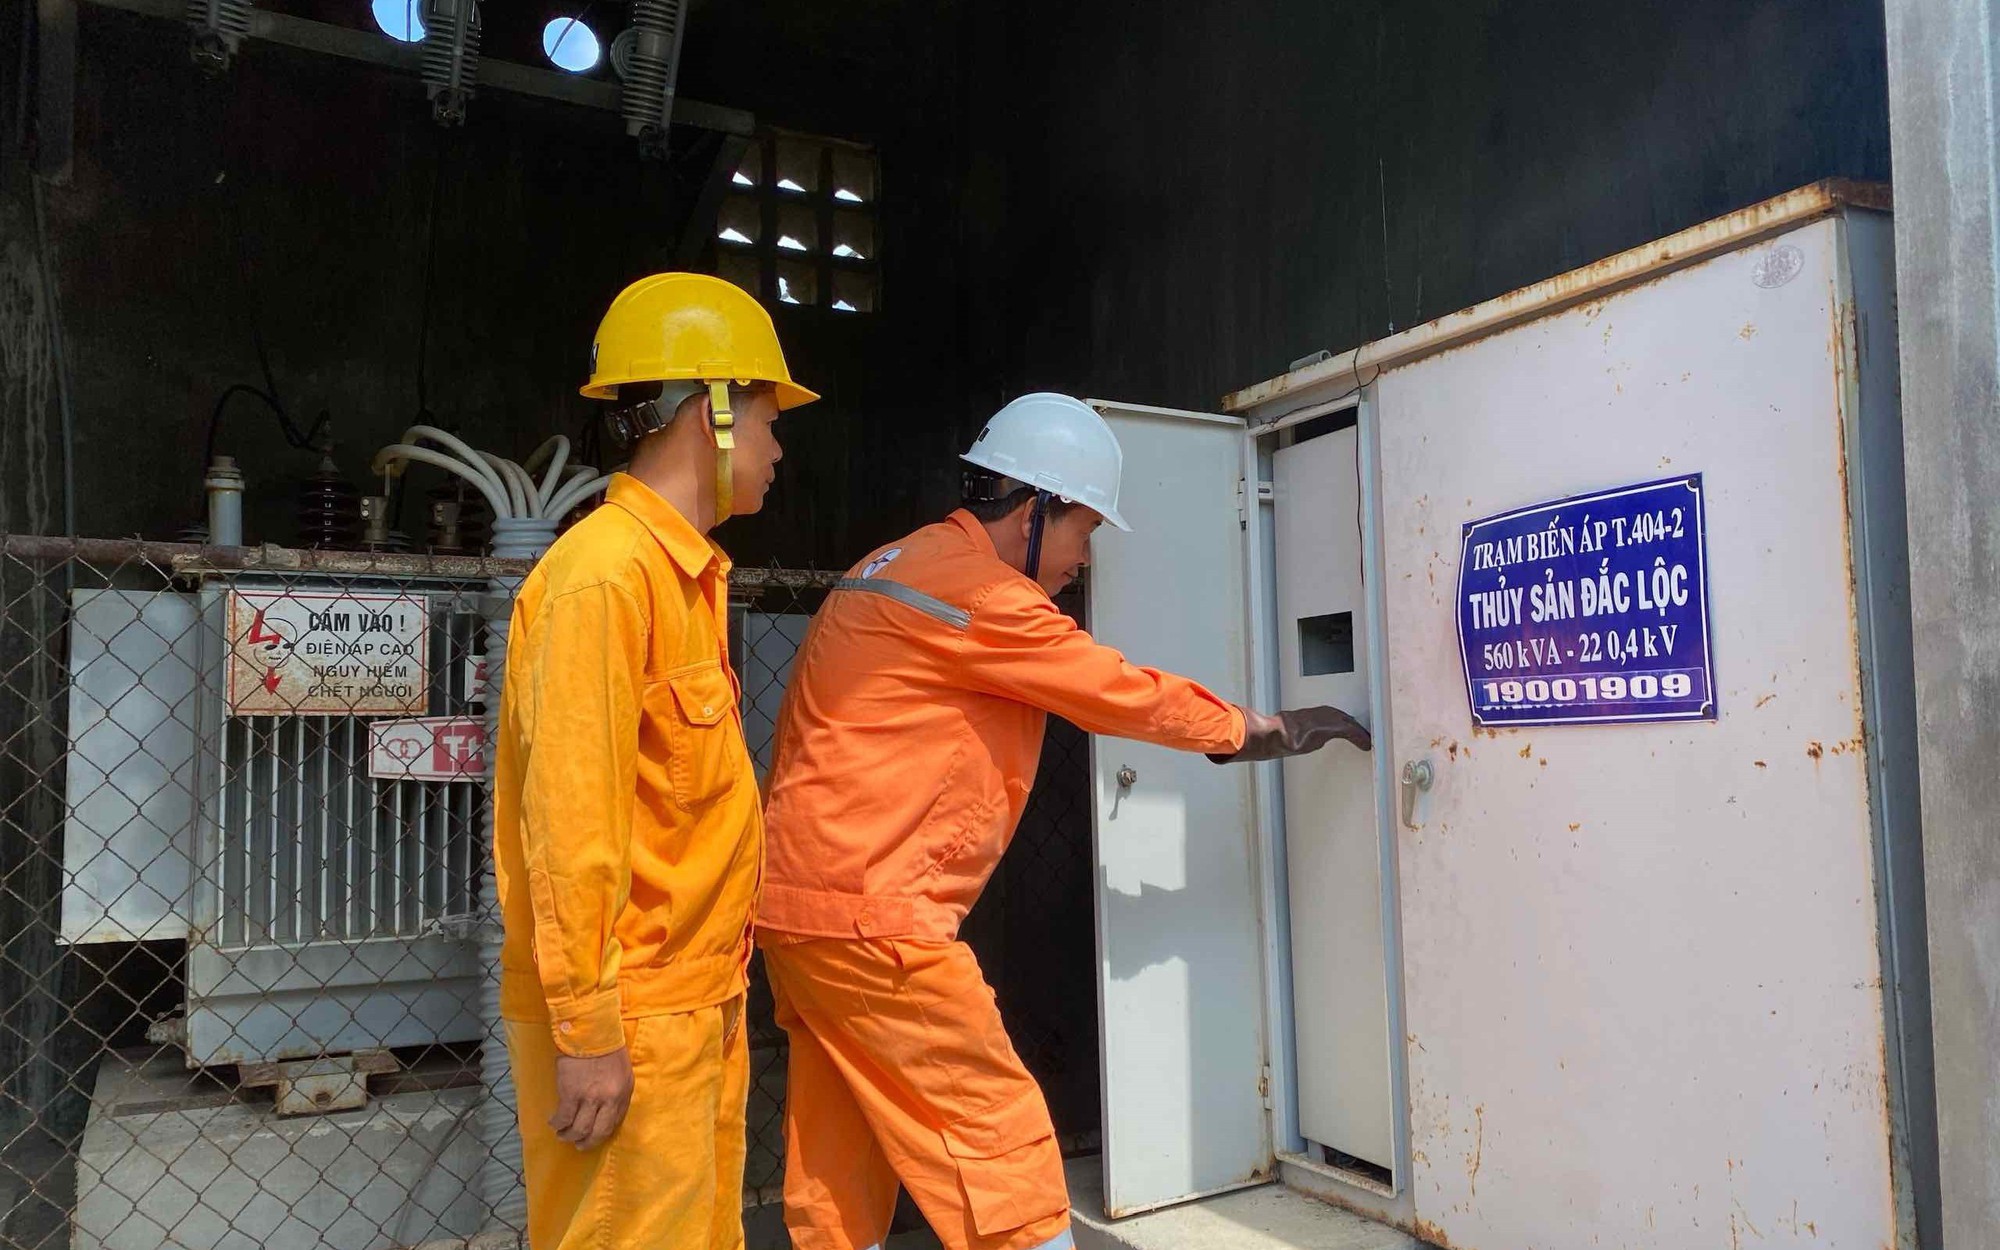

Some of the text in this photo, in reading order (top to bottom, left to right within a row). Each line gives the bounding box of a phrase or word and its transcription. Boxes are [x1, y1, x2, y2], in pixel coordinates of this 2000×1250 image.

[1473, 508, 1684, 573] TRẠM BIẾN ÁP T.404-2
[1469, 556, 1688, 629] THỦY SẢN ĐẮC LỘC
[309, 605, 350, 631] CẤM
[358, 609, 392, 632] VÀO
[306, 639, 346, 657] ĐIỆN
[380, 644, 414, 655] CAO
[1484, 642, 1513, 671] 560
[313, 665, 360, 678] NGUY
[308, 680, 354, 698] CHẾT
[1483, 673, 1692, 703] 19001909
